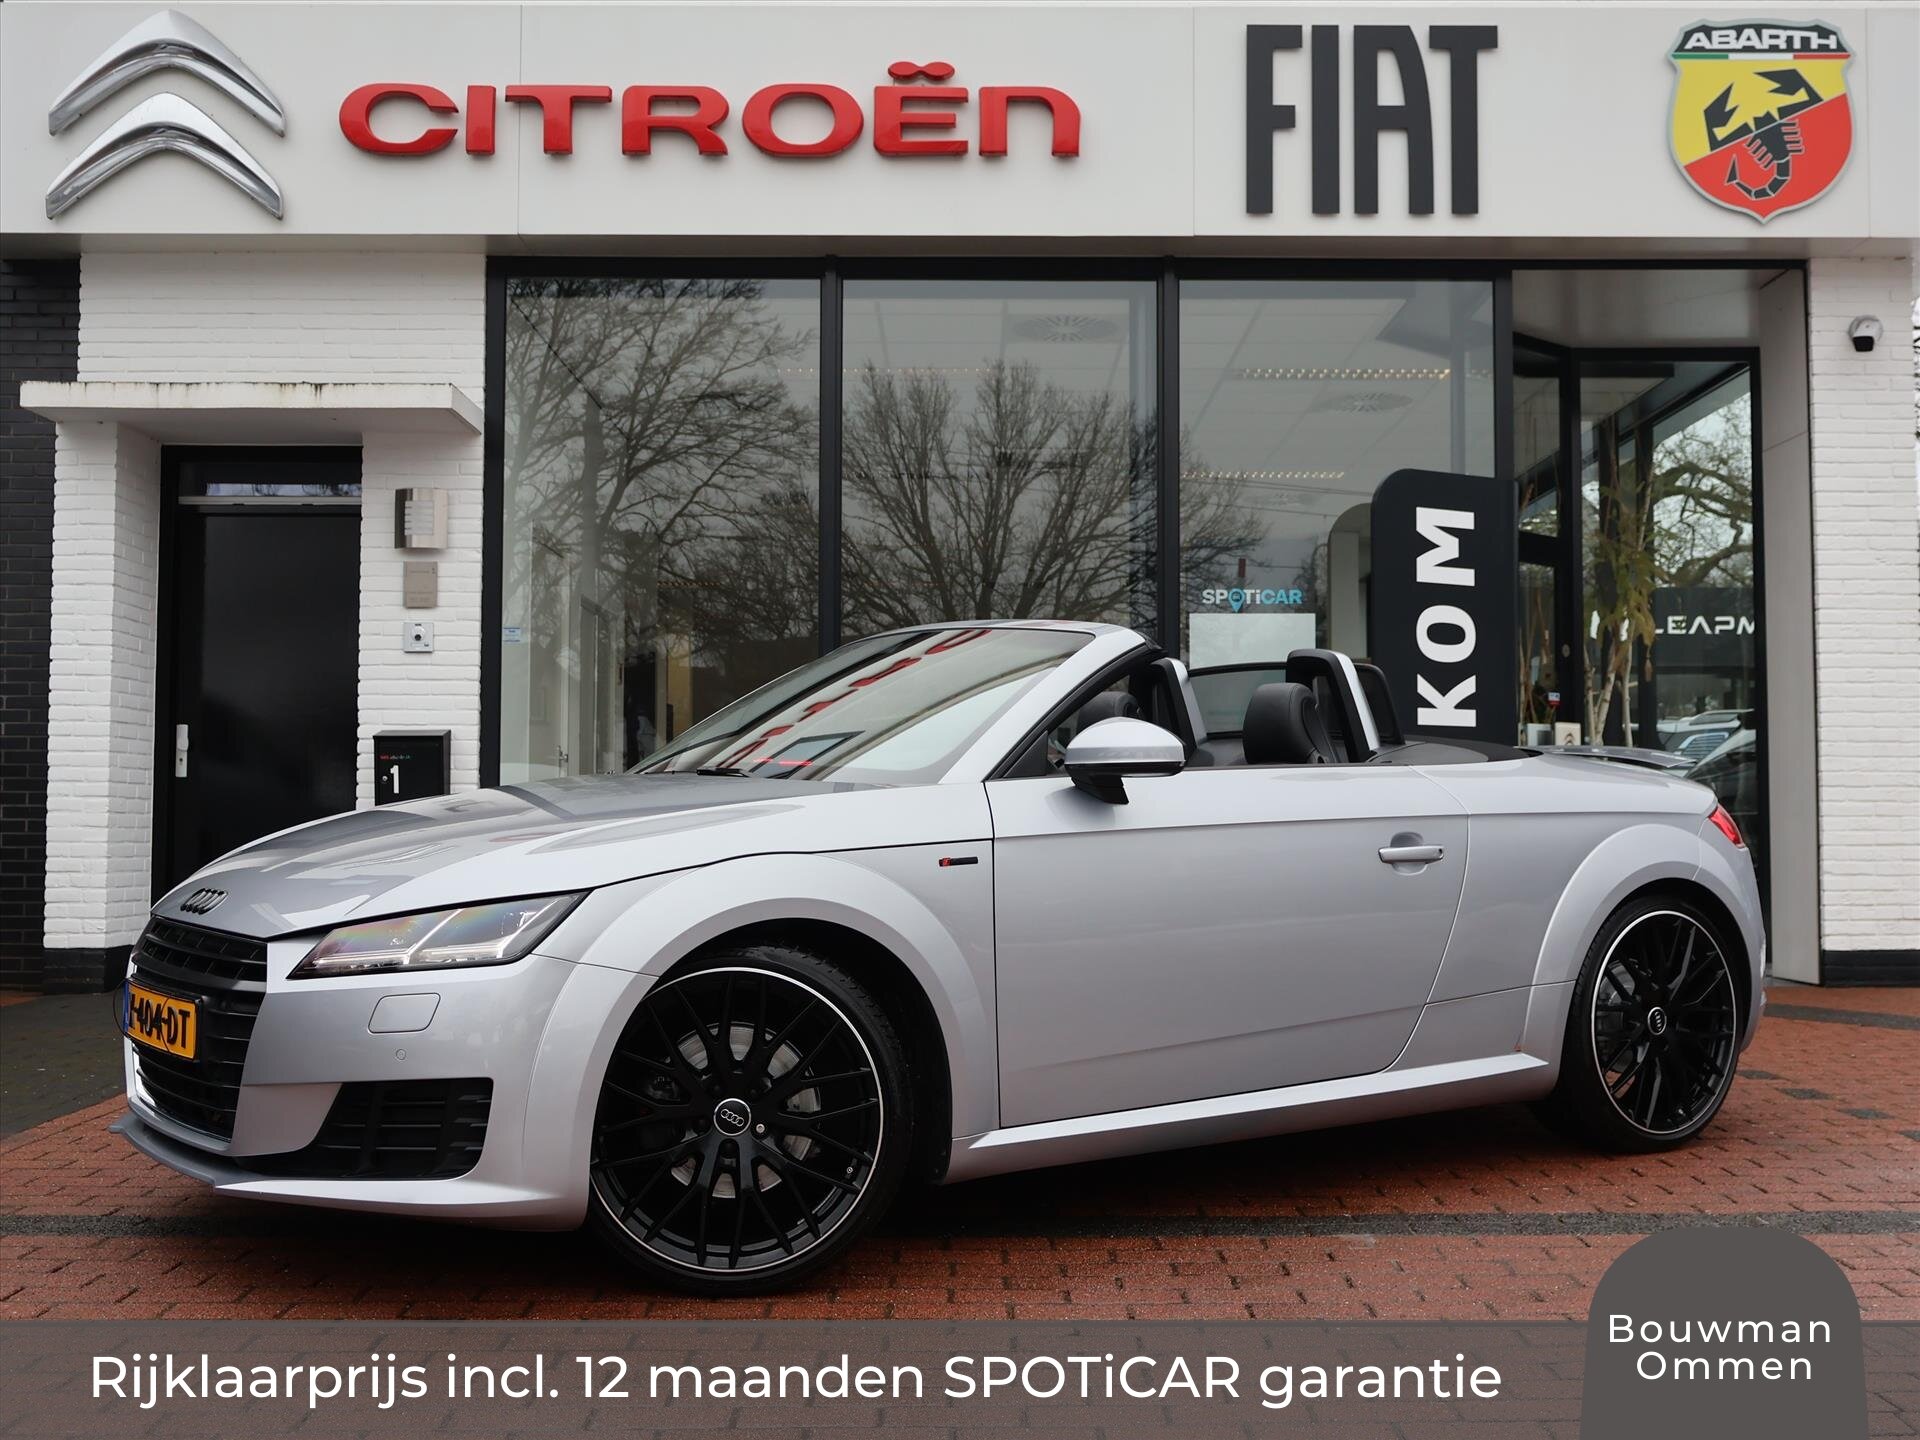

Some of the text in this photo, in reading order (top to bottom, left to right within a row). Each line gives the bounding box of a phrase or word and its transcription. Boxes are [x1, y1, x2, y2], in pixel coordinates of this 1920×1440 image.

[1684, 28, 1838, 50] ABARTH
[340, 61, 1082, 156] CITROËN
[1246, 25, 1498, 216] FIAT
[1415, 506, 1477, 728] KOM
[390, 764, 400, 794] 1
